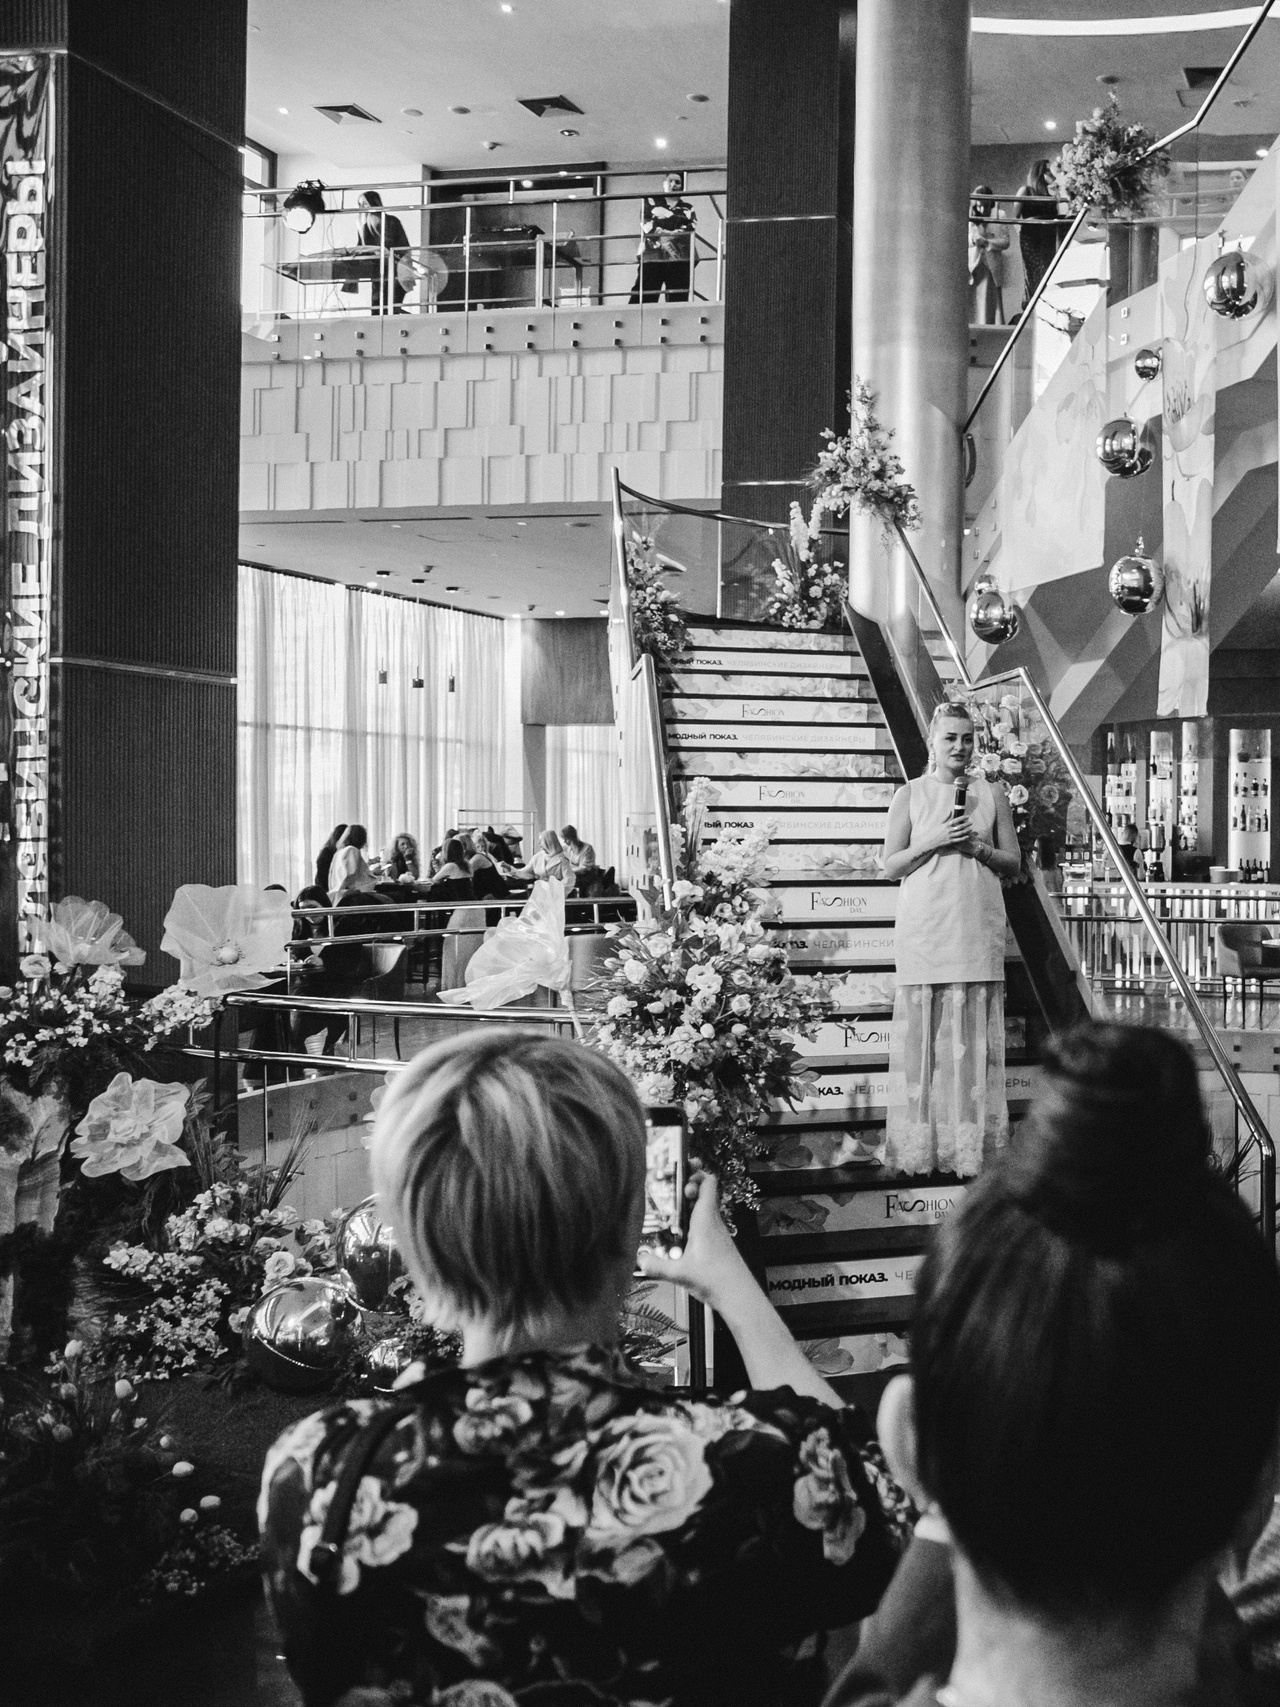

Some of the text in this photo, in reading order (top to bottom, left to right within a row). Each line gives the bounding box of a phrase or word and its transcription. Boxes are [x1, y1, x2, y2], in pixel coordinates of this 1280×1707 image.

[1, 160, 49, 540] ДИЗАЙНЕРЫ
[668, 732, 707, 740] МОДНЫЙ
[834, 820, 887, 830] ДИЗАЙНЕР
[813, 939, 895, 949] ЧЕЛЯБИНСКИ
[818, 1086, 844, 1096] КАЗ.
[769, 1273, 835, 1292] МОДНЫЙ
[839, 1272, 889, 1286] ПОКАЗ.
